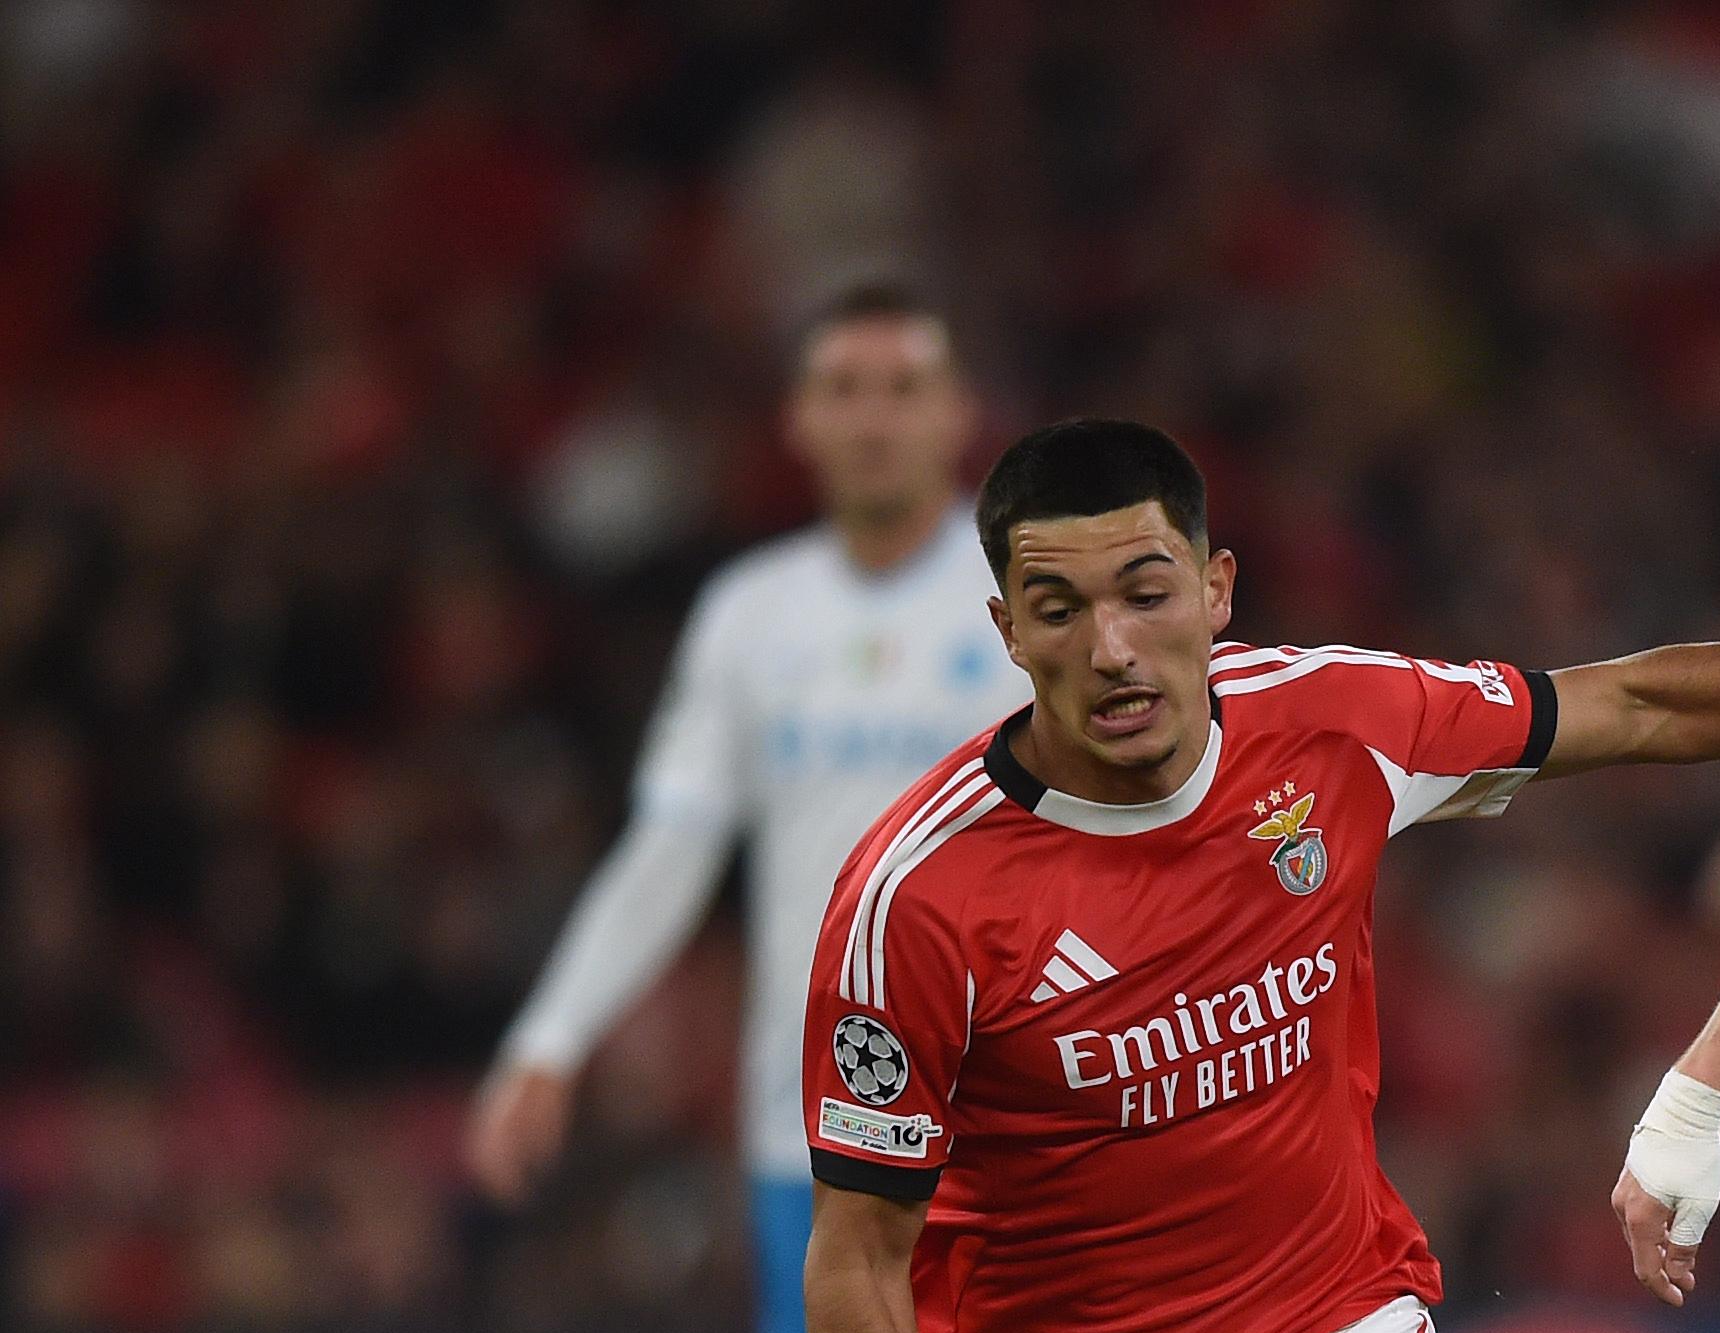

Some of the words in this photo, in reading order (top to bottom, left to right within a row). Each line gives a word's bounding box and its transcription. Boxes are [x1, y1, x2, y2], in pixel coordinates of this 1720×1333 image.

[1052, 942, 1337, 1090] Emirates
[1121, 1071, 1179, 1128] FLY
[1197, 1016, 1311, 1109] BETTER
[823, 1113, 888, 1139] FOUNDATION
